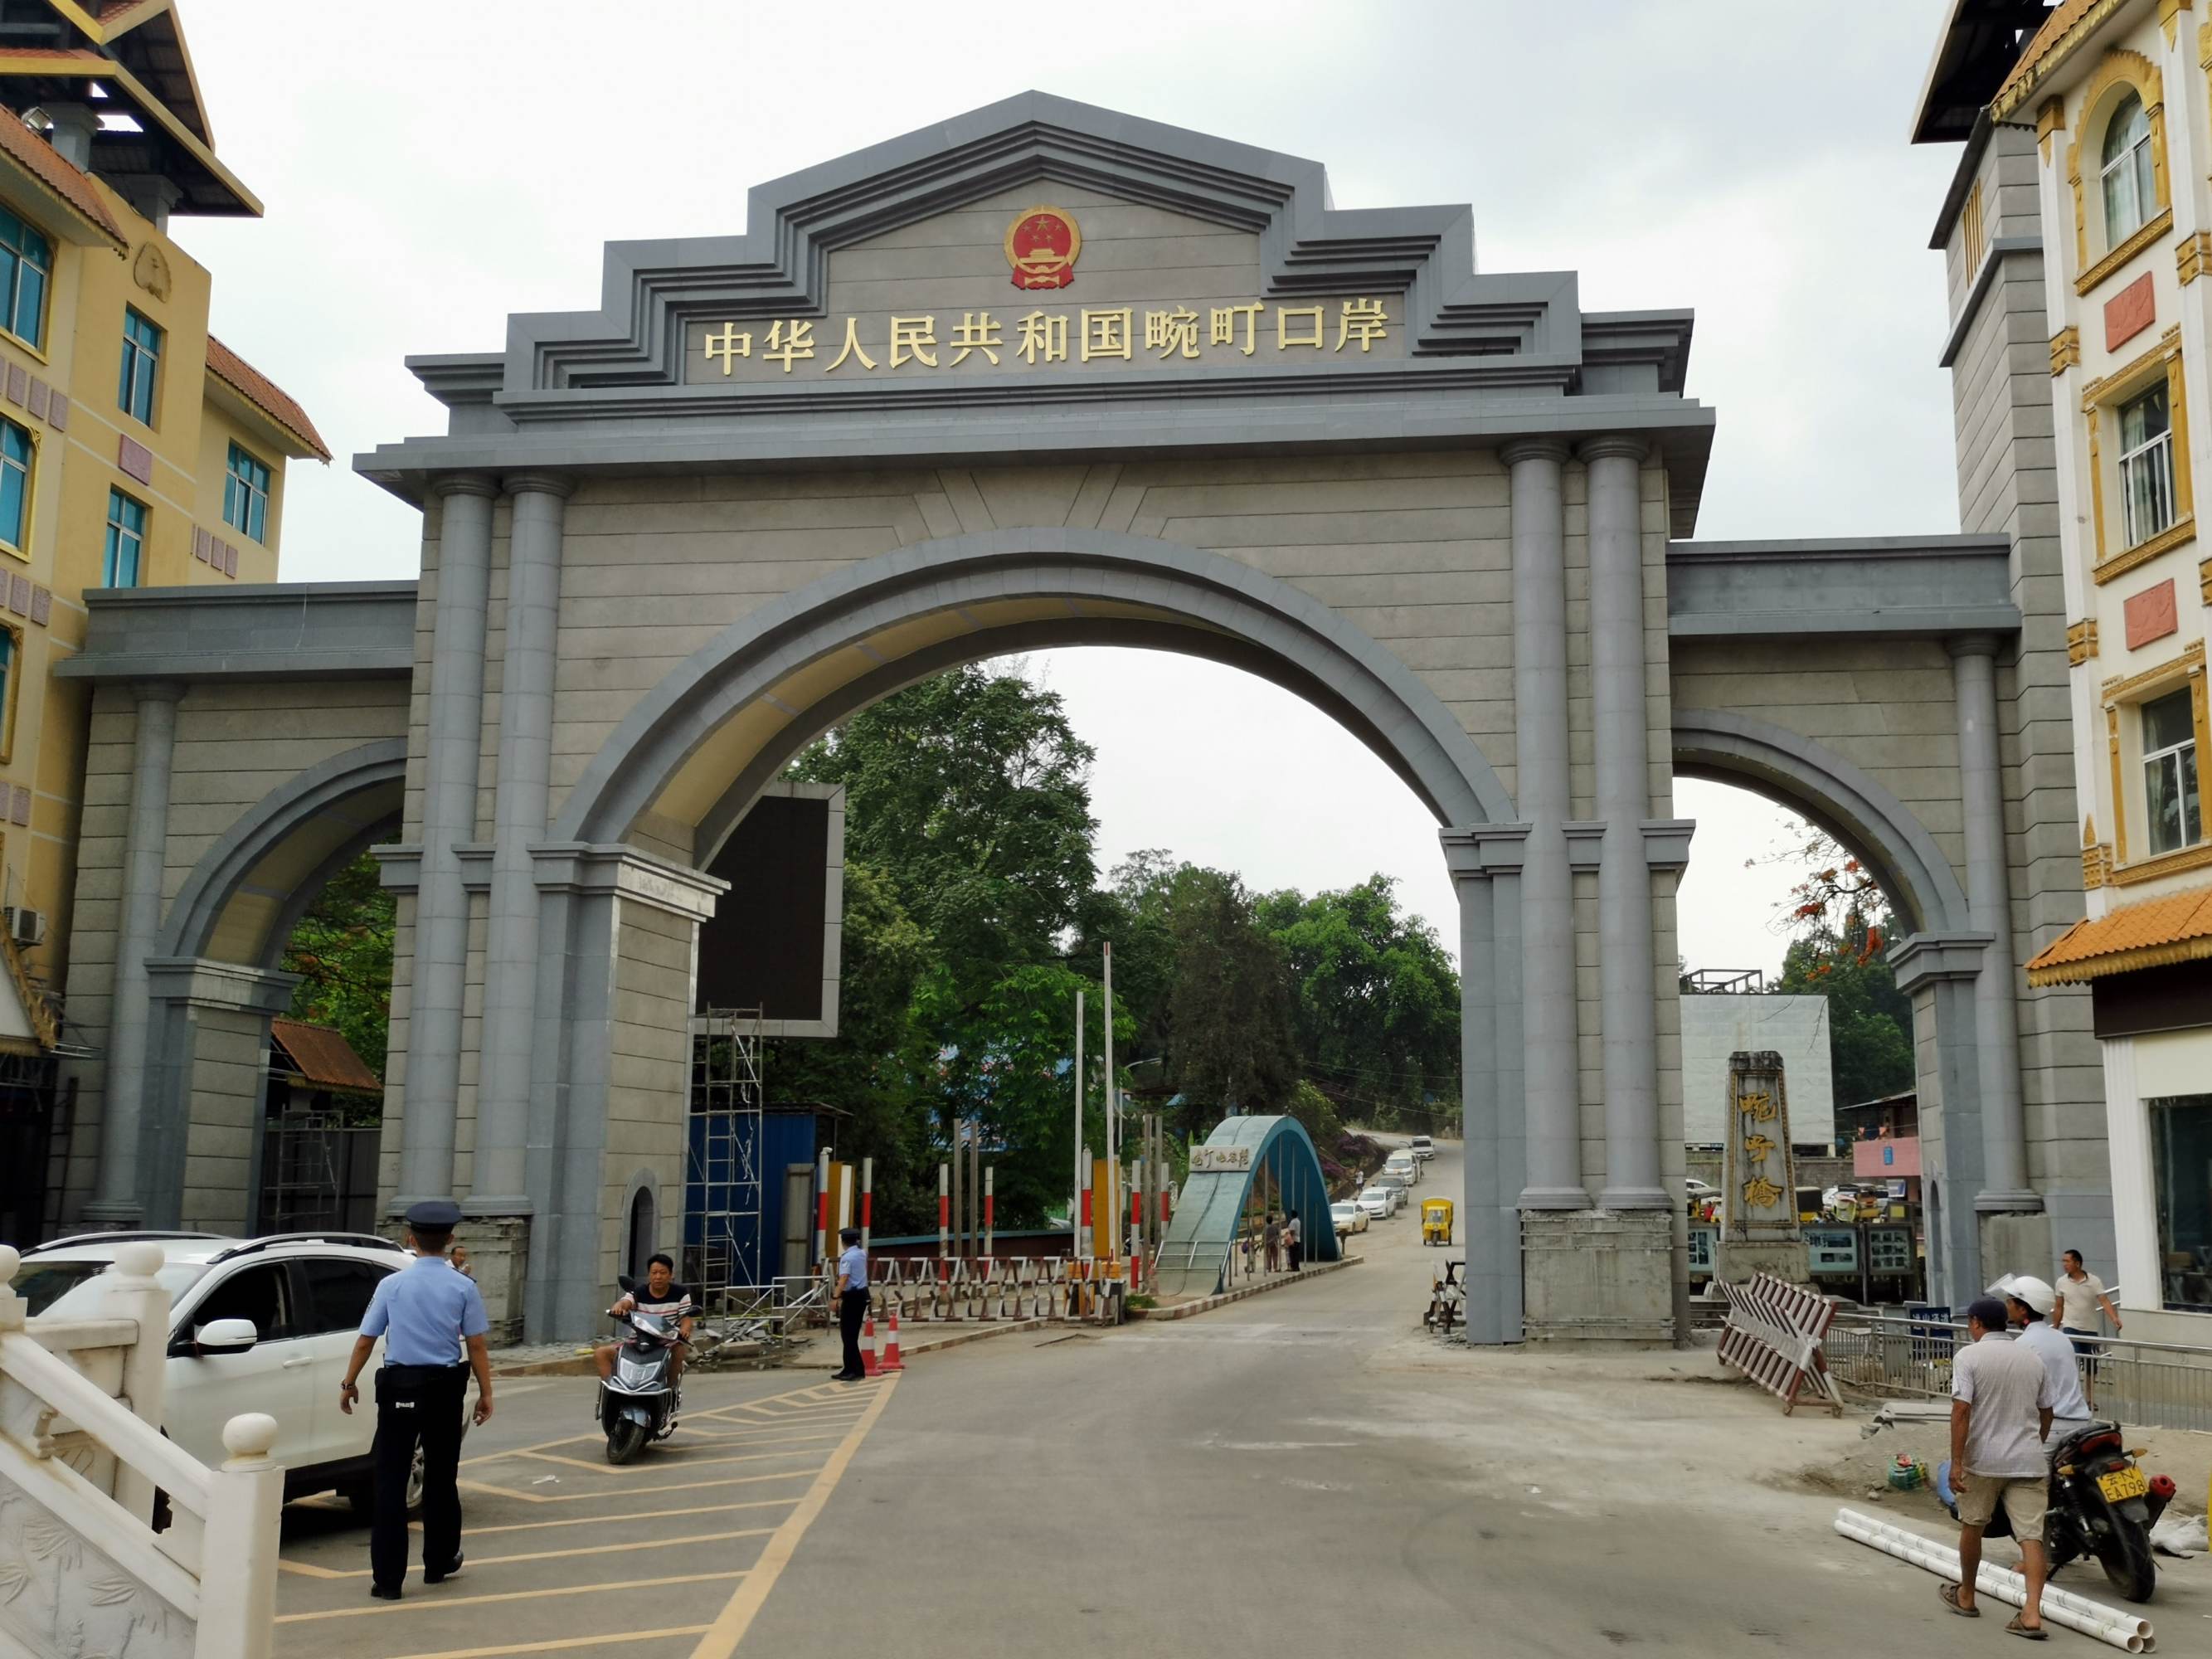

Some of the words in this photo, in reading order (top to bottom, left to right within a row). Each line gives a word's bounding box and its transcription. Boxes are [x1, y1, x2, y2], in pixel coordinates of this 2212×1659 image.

[704, 298, 1389, 376] 中华人民共和国畹町口岸
[2104, 1480, 2146, 1501] EA798
